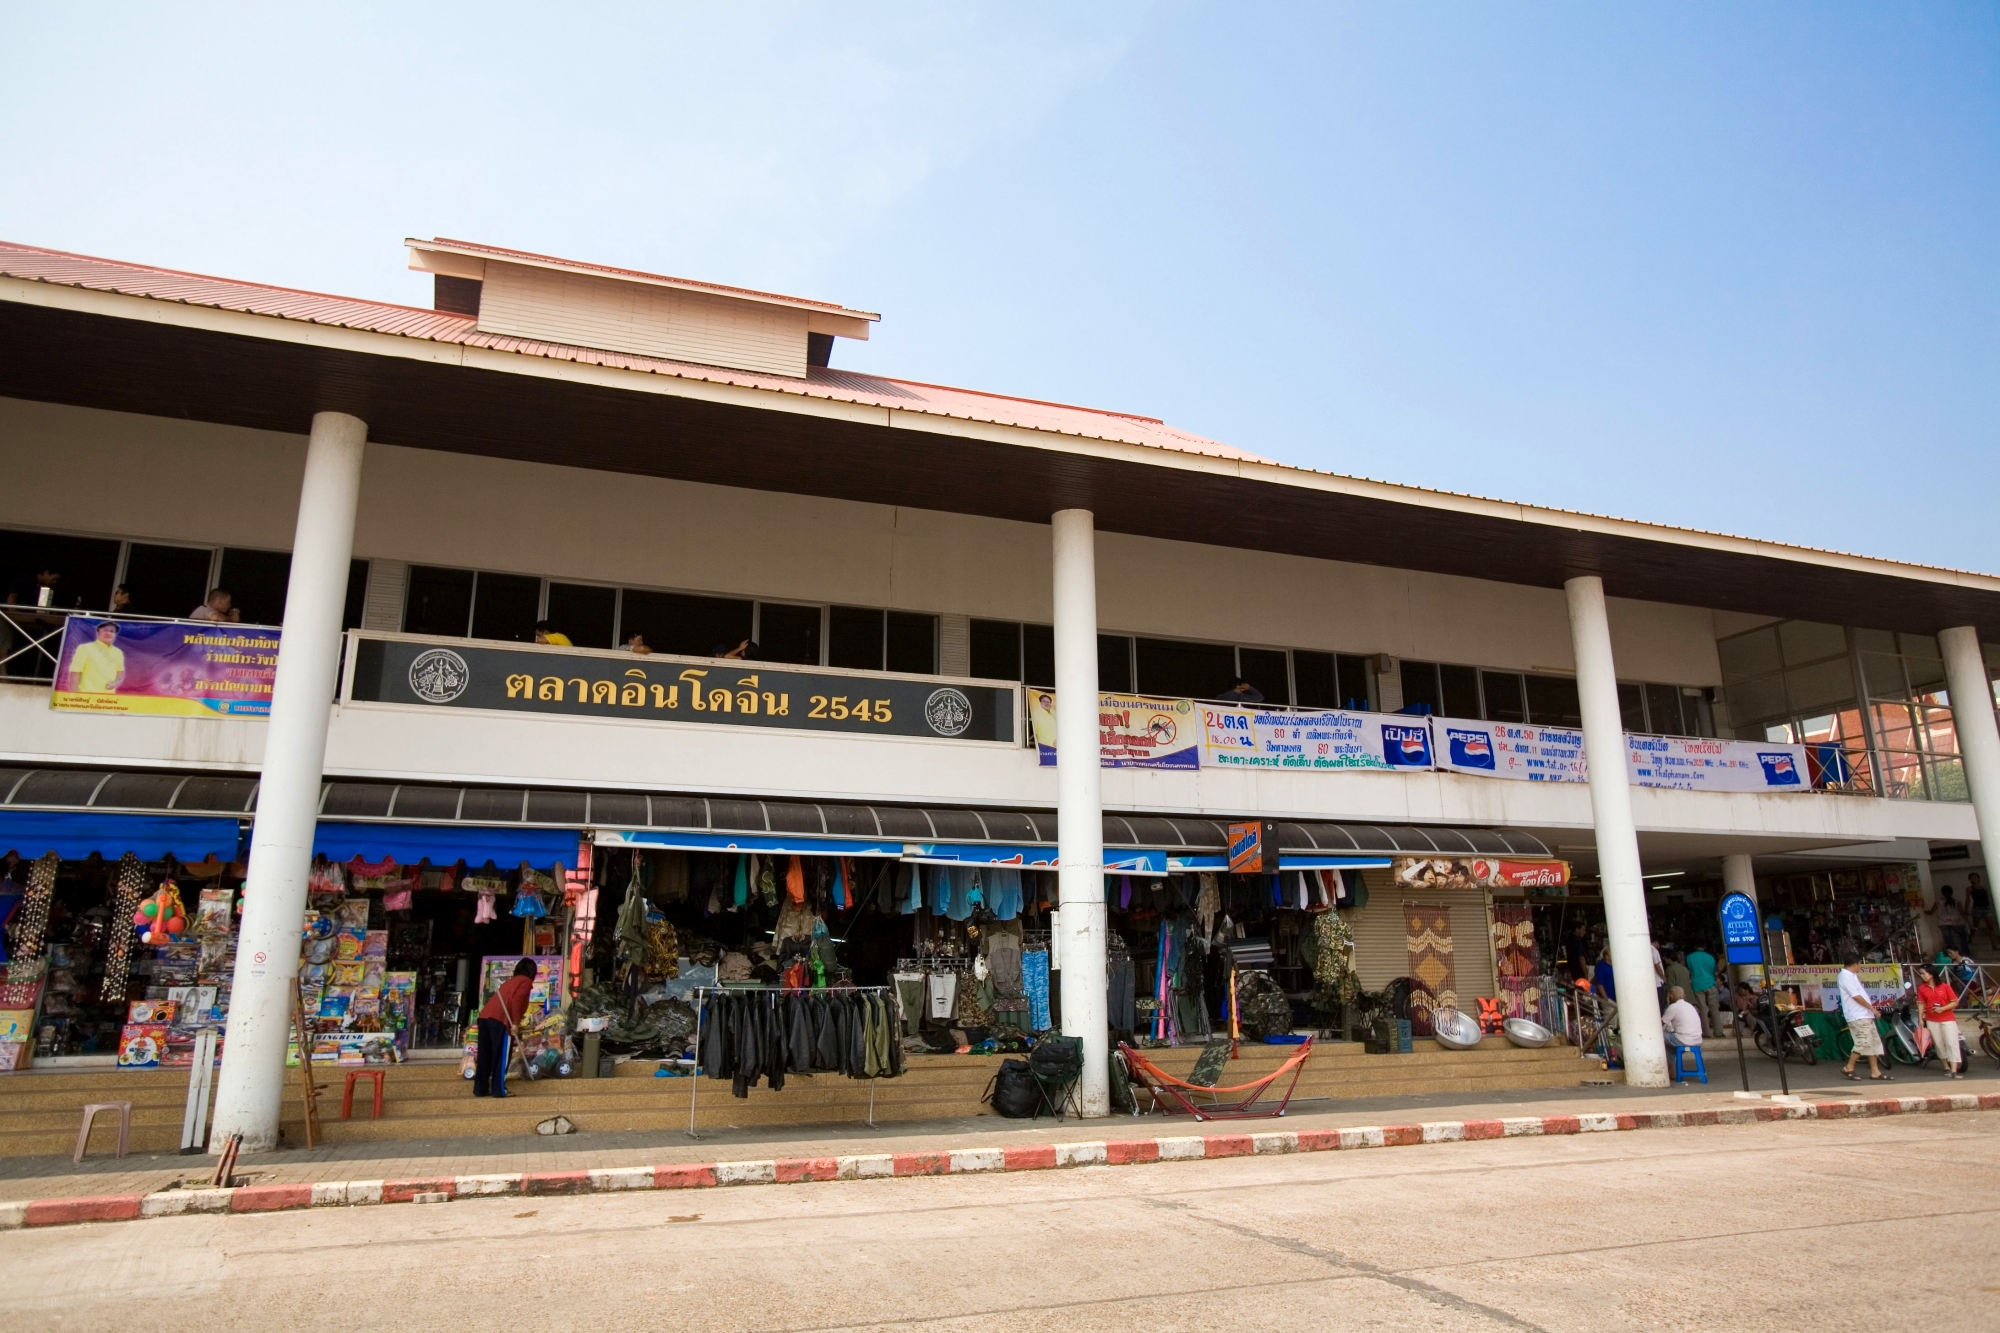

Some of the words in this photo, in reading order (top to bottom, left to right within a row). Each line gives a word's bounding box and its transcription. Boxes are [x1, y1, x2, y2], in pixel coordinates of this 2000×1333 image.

[184, 633, 280, 649] พลังแผ่นดินท้อง
[505, 668, 790, 717] ตลาดอินโดจีน
[807, 695, 893, 723] 2545
[1274, 728, 1285, 738] 80
[1450, 731, 1488, 744] PEPSI
[1318, 743, 1329, 754] 80
